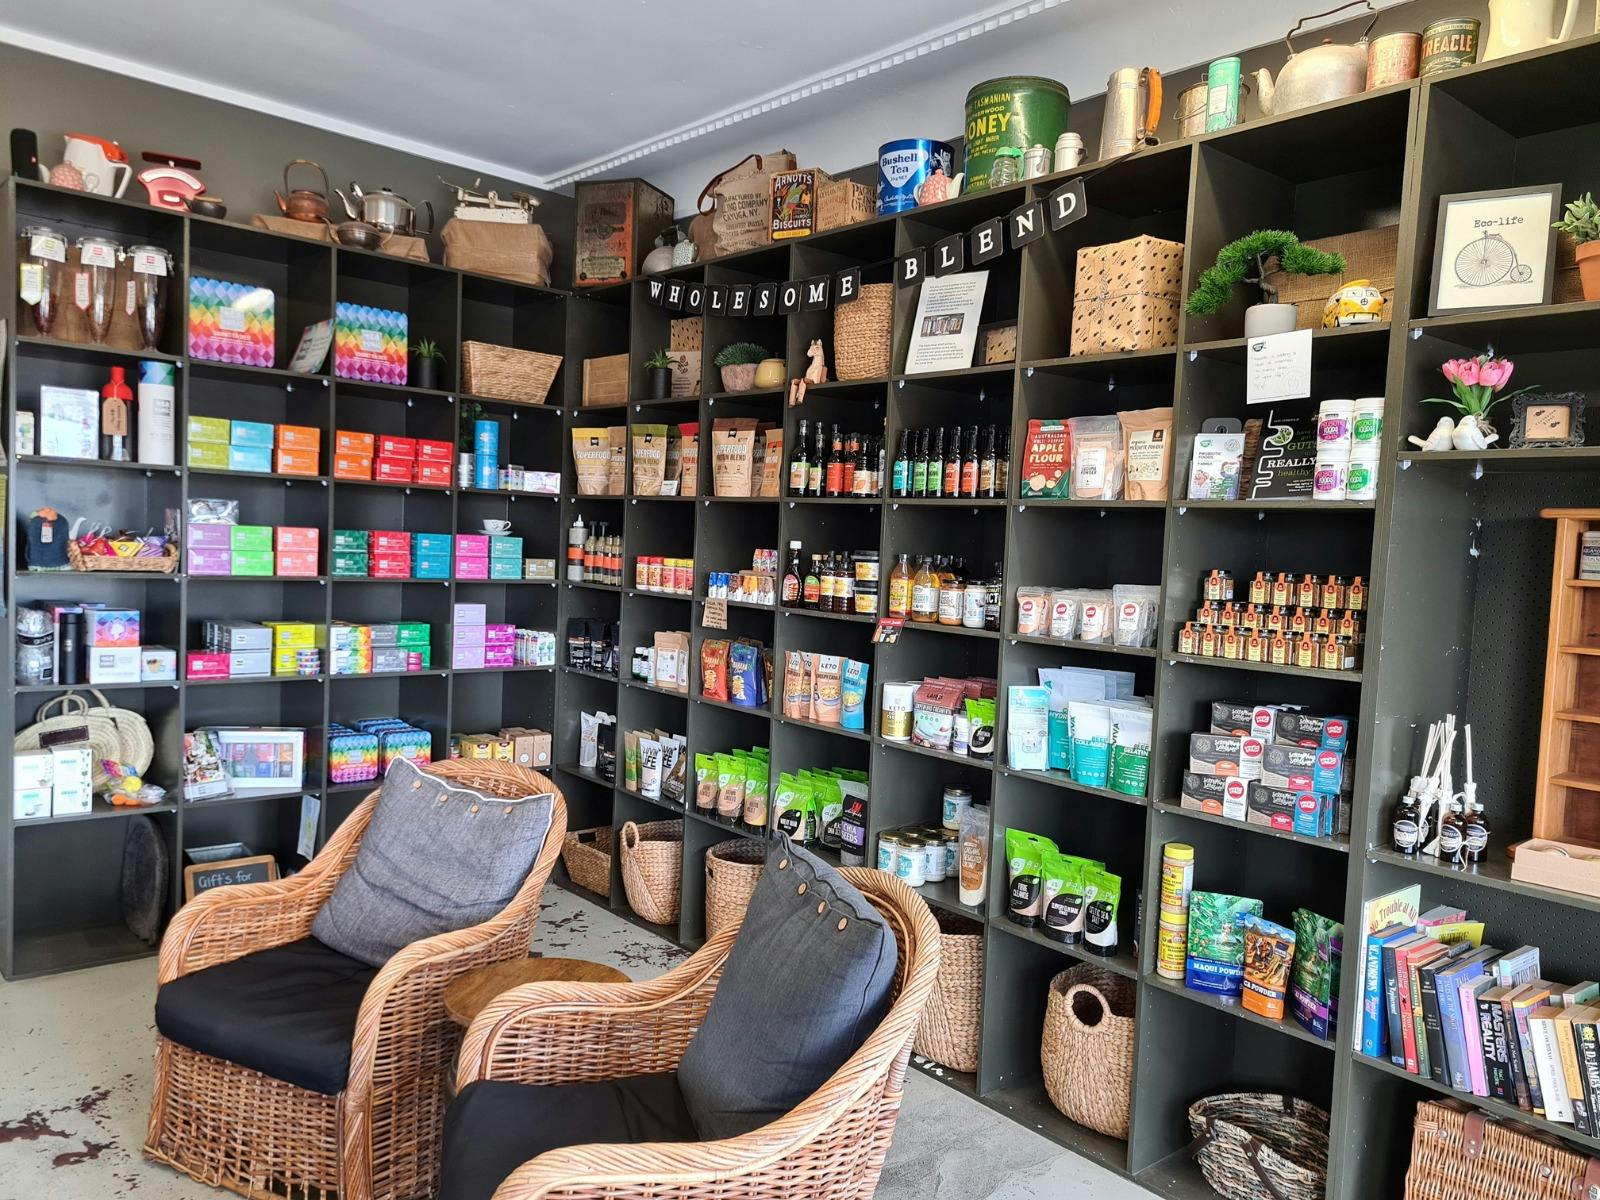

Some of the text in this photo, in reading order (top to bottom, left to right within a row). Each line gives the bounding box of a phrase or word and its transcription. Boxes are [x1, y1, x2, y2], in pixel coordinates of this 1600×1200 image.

[1423, 34, 1473, 60] TREACLE
[974, 92, 1011, 107] TASMANIAN
[890, 165, 909, 175] Tea
[738, 197, 769, 210] COMPANY
[772, 218, 812, 230] BISCUITS
[1473, 215, 1524, 229] Eco-life
[905, 191, 1077, 281] BLEND
[650, 275, 854, 310] WHOLESOME
[1030, 443, 1065, 453] APPLE
[1029, 453, 1064, 464] FLOUR
[1266, 456, 1317, 469] REALLY
[841, 832, 858, 844] SEEDS
[235, 870, 253, 882] for
[1379, 898, 1401, 922] Trouble
[1193, 962, 1219, 974] MAQUI
[1251, 984, 1278, 998] POWDER
[1480, 1012, 1497, 1061] REALITY
[1491, 1003, 1508, 1063] MASTERS
[1585, 1059, 1600, 1089] JAMES
